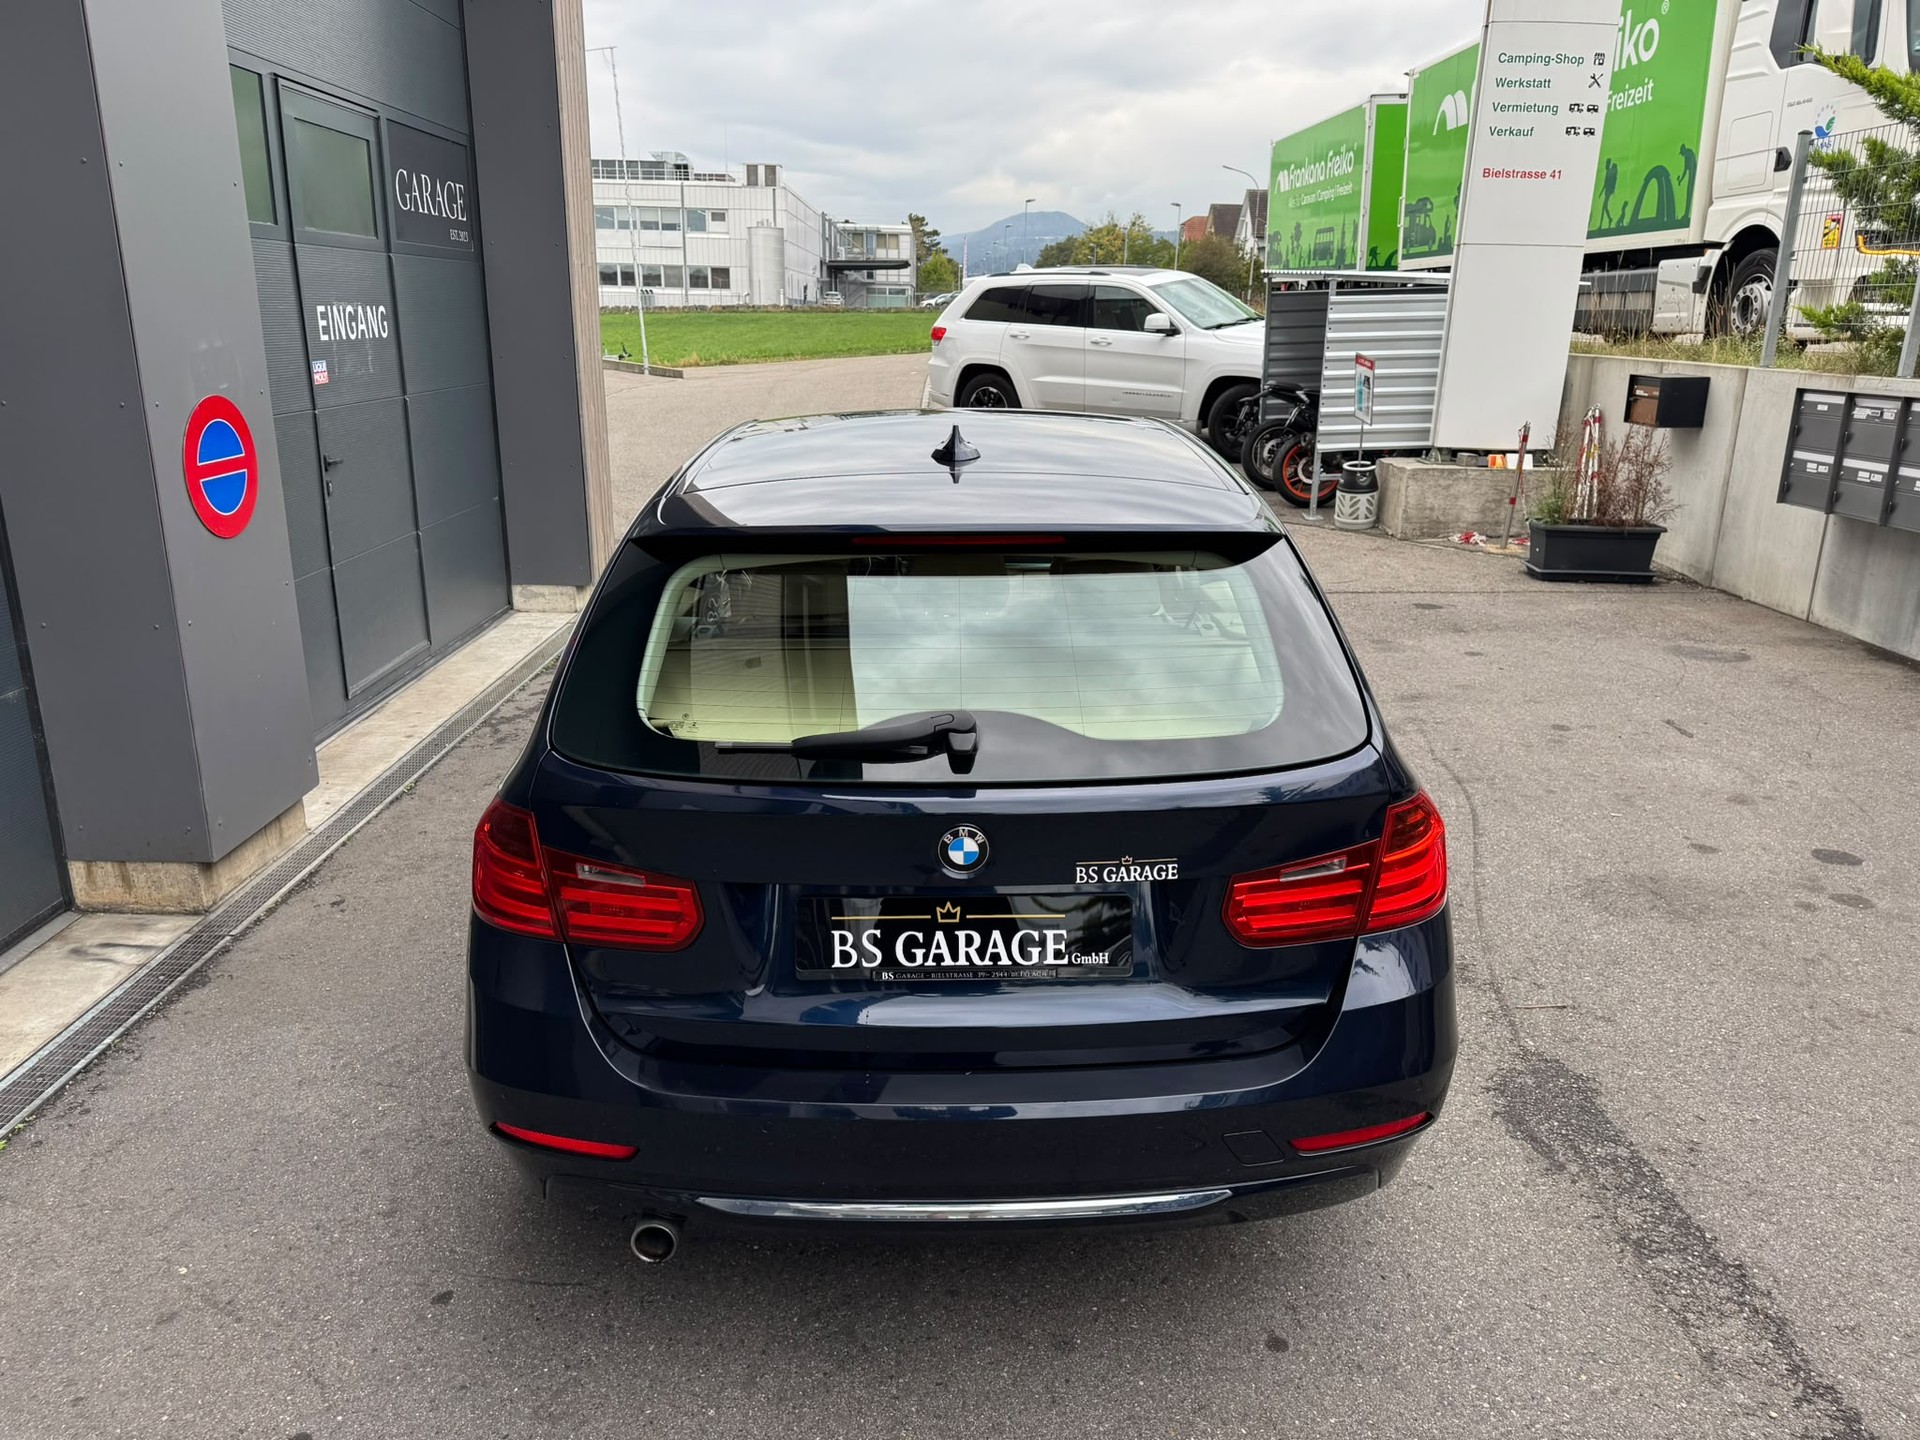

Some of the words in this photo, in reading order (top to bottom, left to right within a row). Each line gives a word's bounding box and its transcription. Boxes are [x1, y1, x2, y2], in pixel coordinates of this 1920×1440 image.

[1614, 9, 1660, 72] iko
[1498, 52, 1585, 67] Camping-Shop
[1495, 77, 1551, 89] Werkstatt
[1492, 102, 1559, 116] Vermietung
[1489, 126, 1534, 137] Verkauf
[1289, 157, 1325, 190] Frankana
[1327, 143, 1355, 179] Freiko
[1482, 168, 1547, 180] Bielstrasse
[1550, 169, 1562, 180] 41
[395, 168, 467, 222] GARAGE
[316, 305, 388, 341] EINGANG
[943, 828, 985, 845] BMW
[1076, 866, 1098, 884] BS
[1103, 864, 1178, 883] GARAGE
[831, 929, 882, 968] BS
[895, 929, 1068, 967] GARAGE
[1071, 952, 1110, 965] GmbH
[882, 972, 894, 980] BS
